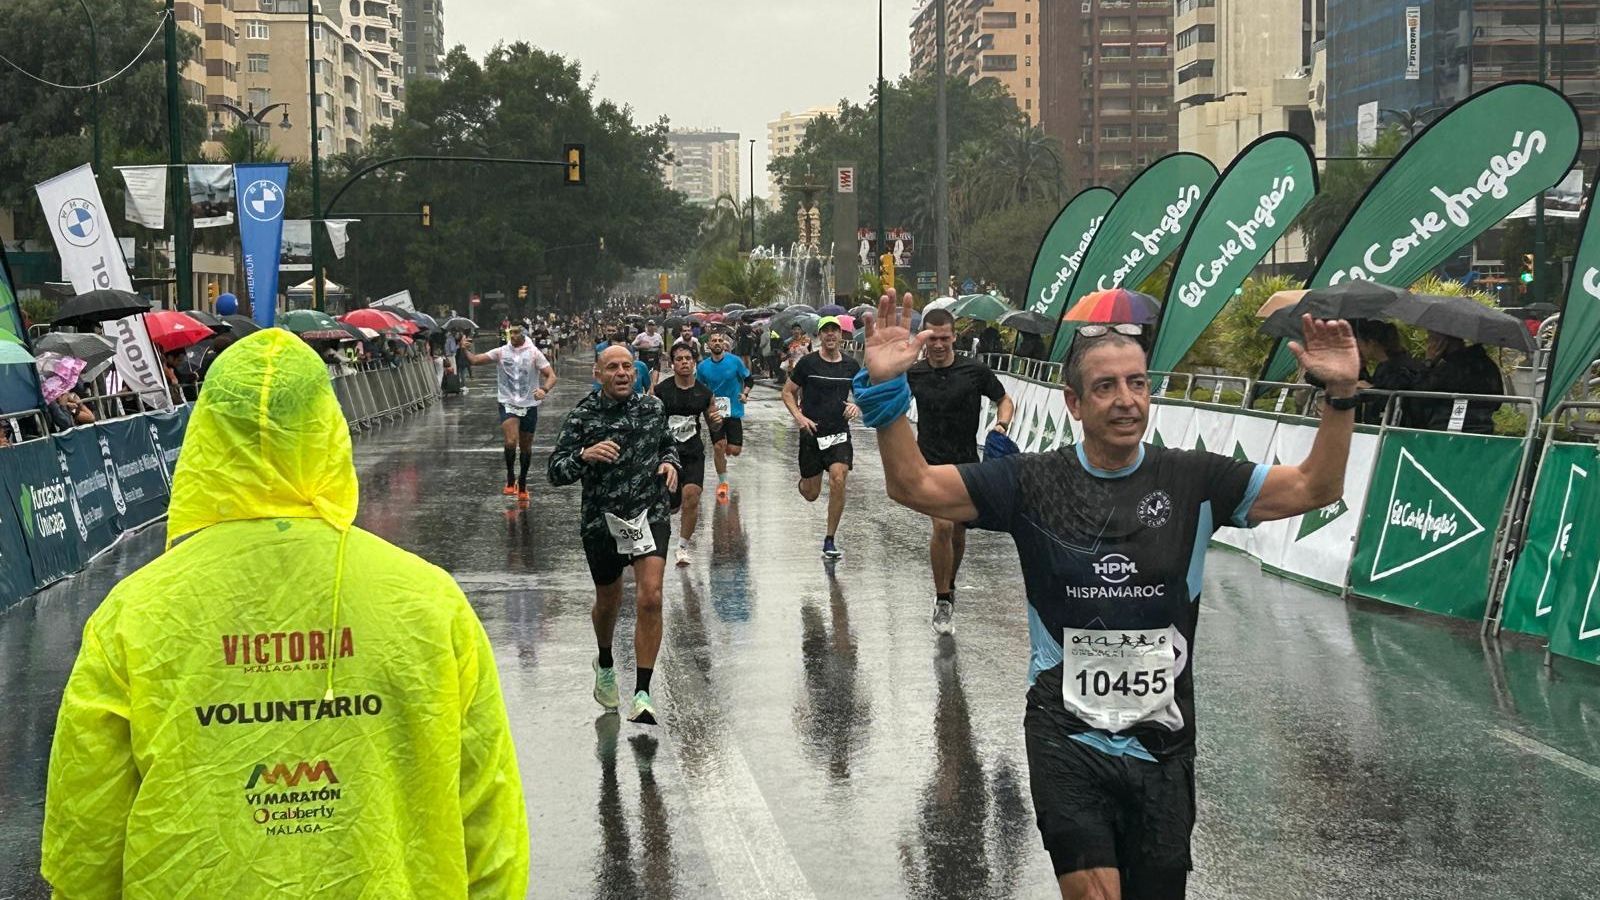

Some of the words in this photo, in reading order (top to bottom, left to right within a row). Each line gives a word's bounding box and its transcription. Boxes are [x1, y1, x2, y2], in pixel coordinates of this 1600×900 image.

[249, 181, 278, 195] BMW
[1363, 211, 1447, 275] Corte
[1430, 130, 1546, 227] Inglés
[1097, 248, 1146, 292] Corte
[1131, 184, 1200, 255] Inglés
[1178, 284, 1207, 308] El
[1195, 239, 1243, 288] Corte
[1226, 175, 1294, 250] Inglés
[245, 254, 255, 300] PREMIUM
[1040, 266, 1072, 304] Corte
[35, 507, 67, 540] Unicaja
[1390, 499, 1403, 525] El
[1401, 502, 1425, 531] Corte
[1420, 499, 1458, 543] Inglés
[1092, 562, 1139, 574] HPM
[1065, 584, 1165, 599] HISPAMAROC
[1075, 669, 1167, 697] 10455
[195, 694, 382, 727] VOLUNTARIO
[246, 793, 261, 805] VI
[264, 786, 341, 805] MARATÓN
[271, 804, 335, 821] cabberty
[266, 823, 322, 836] MÁLAGA
